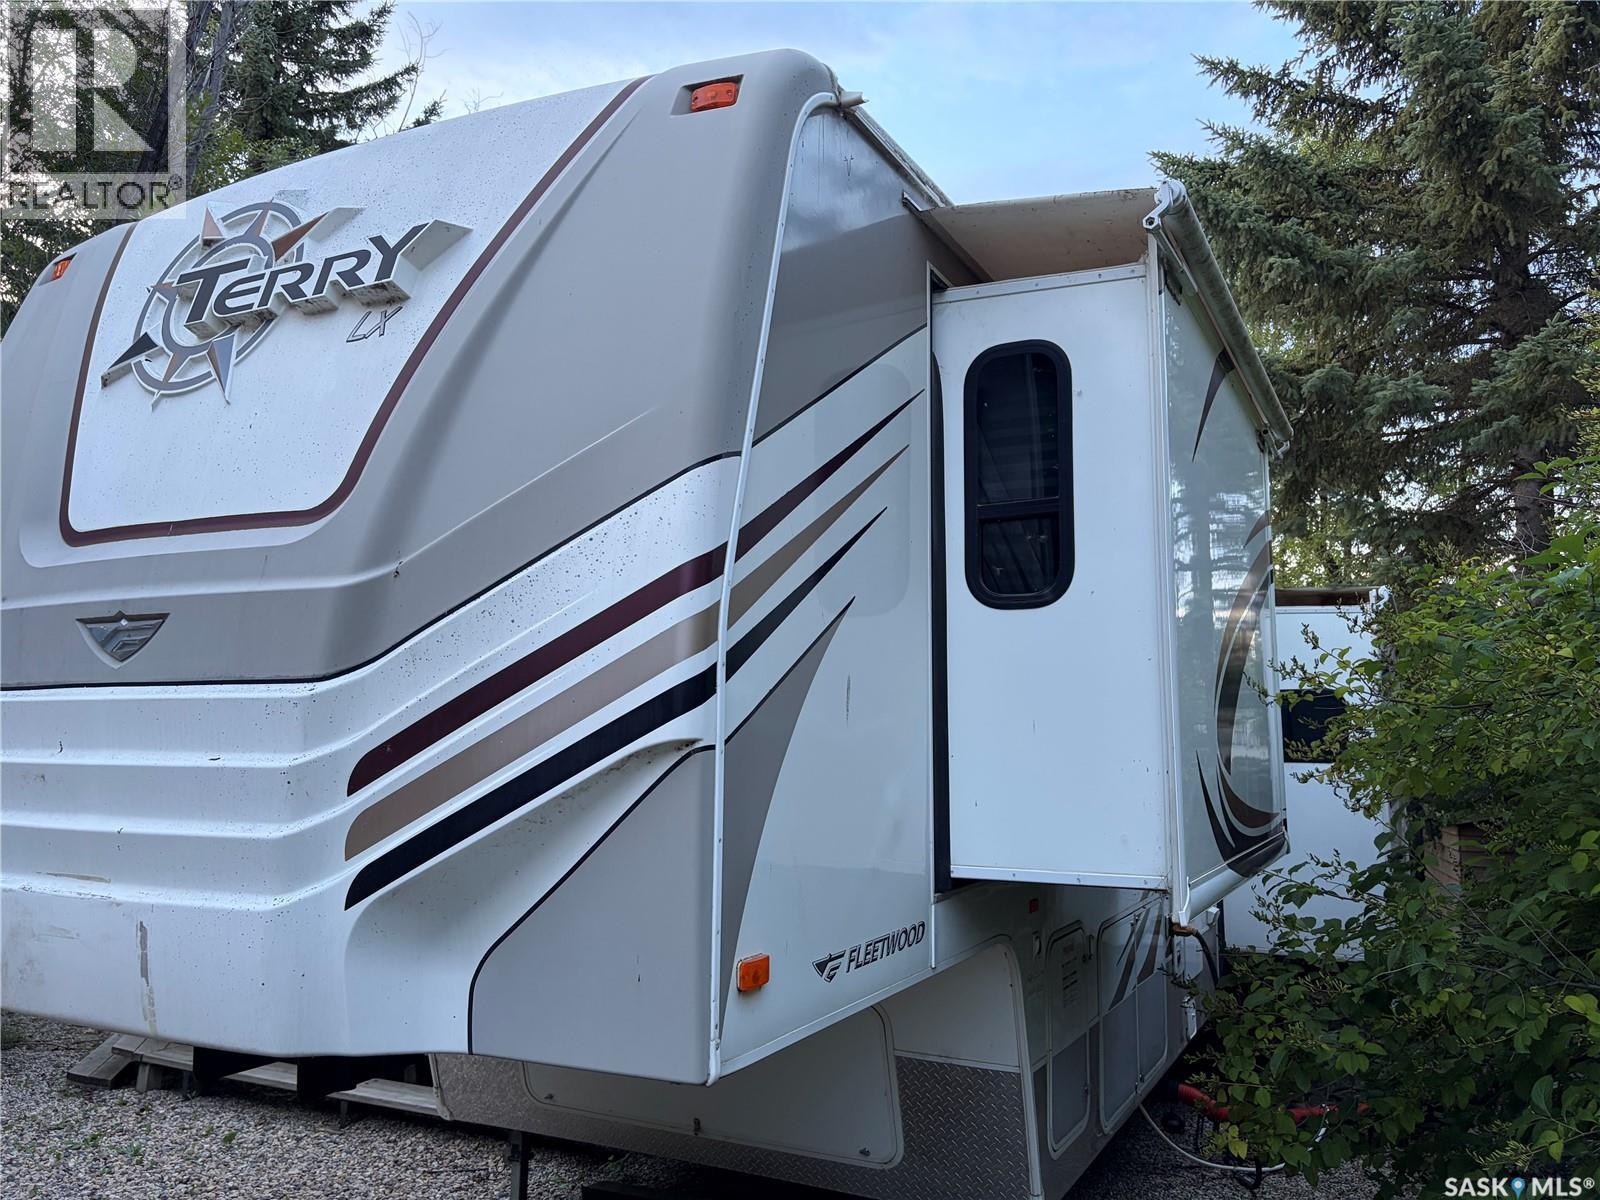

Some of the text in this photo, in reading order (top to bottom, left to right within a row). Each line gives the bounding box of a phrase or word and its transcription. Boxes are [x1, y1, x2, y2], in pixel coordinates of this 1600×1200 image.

[174, 221, 432, 326] TERRY
[346, 305, 403, 343] LX
[846, 920, 926, 973] FLEETWOOD
